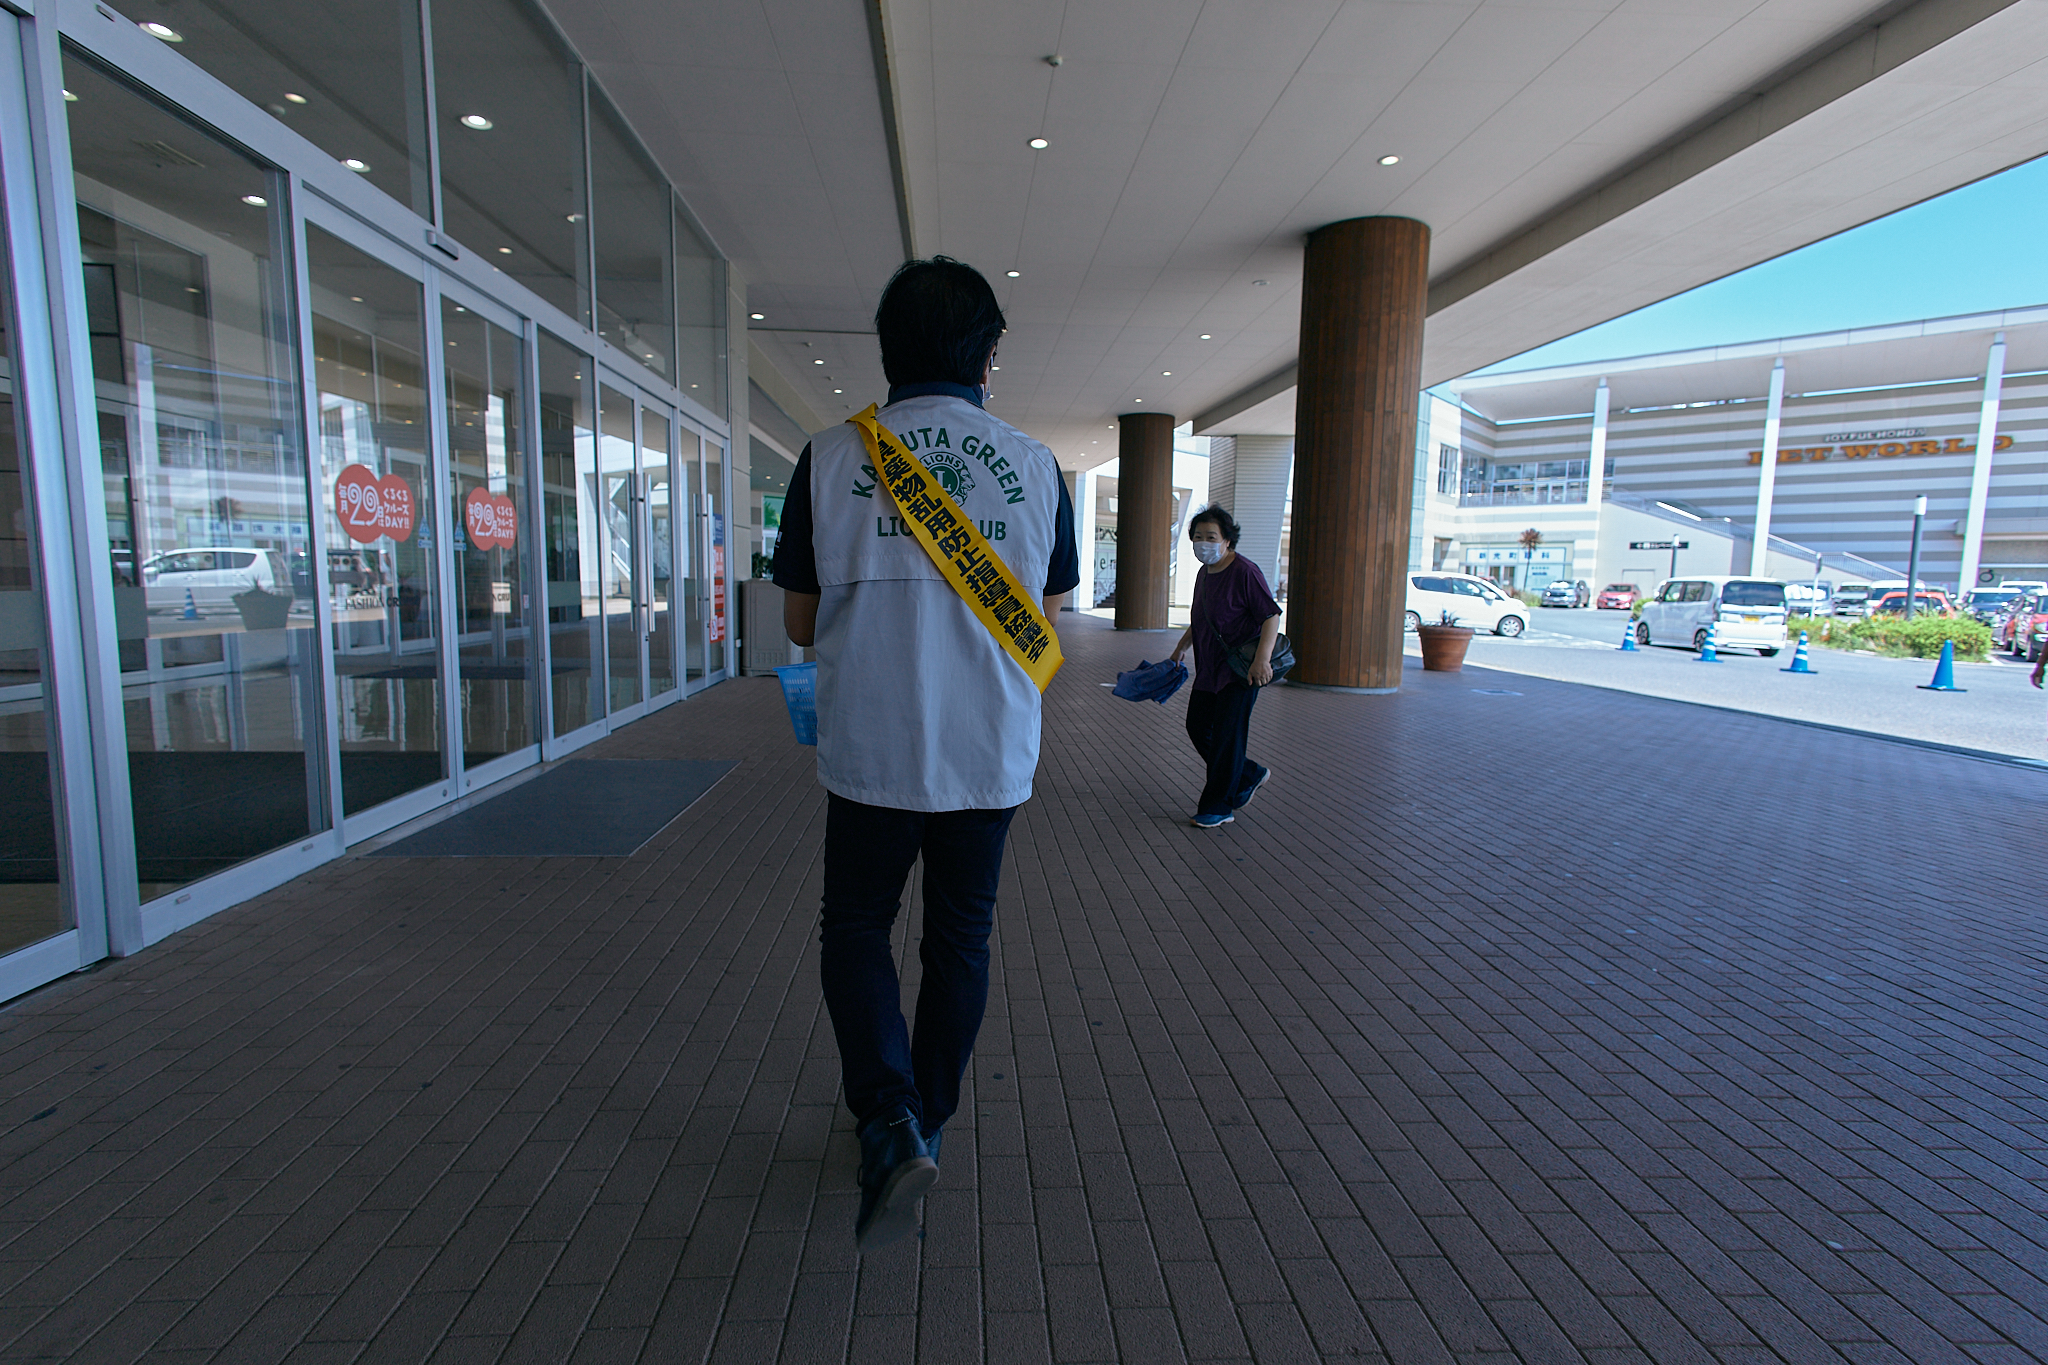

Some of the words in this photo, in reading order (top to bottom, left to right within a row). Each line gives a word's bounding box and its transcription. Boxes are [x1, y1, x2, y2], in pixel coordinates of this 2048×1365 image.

[1840, 435, 2014, 459] WORLD
[851, 427, 951, 499] KAUTA
[961, 434, 1025, 506] GREEN
[923, 454, 962, 470] LIONS
[383, 487, 408, 502] くるくる
[383, 501, 410, 516] クルーズ
[877, 516, 916, 538] LIO
[970, 518, 1008, 541] UB
